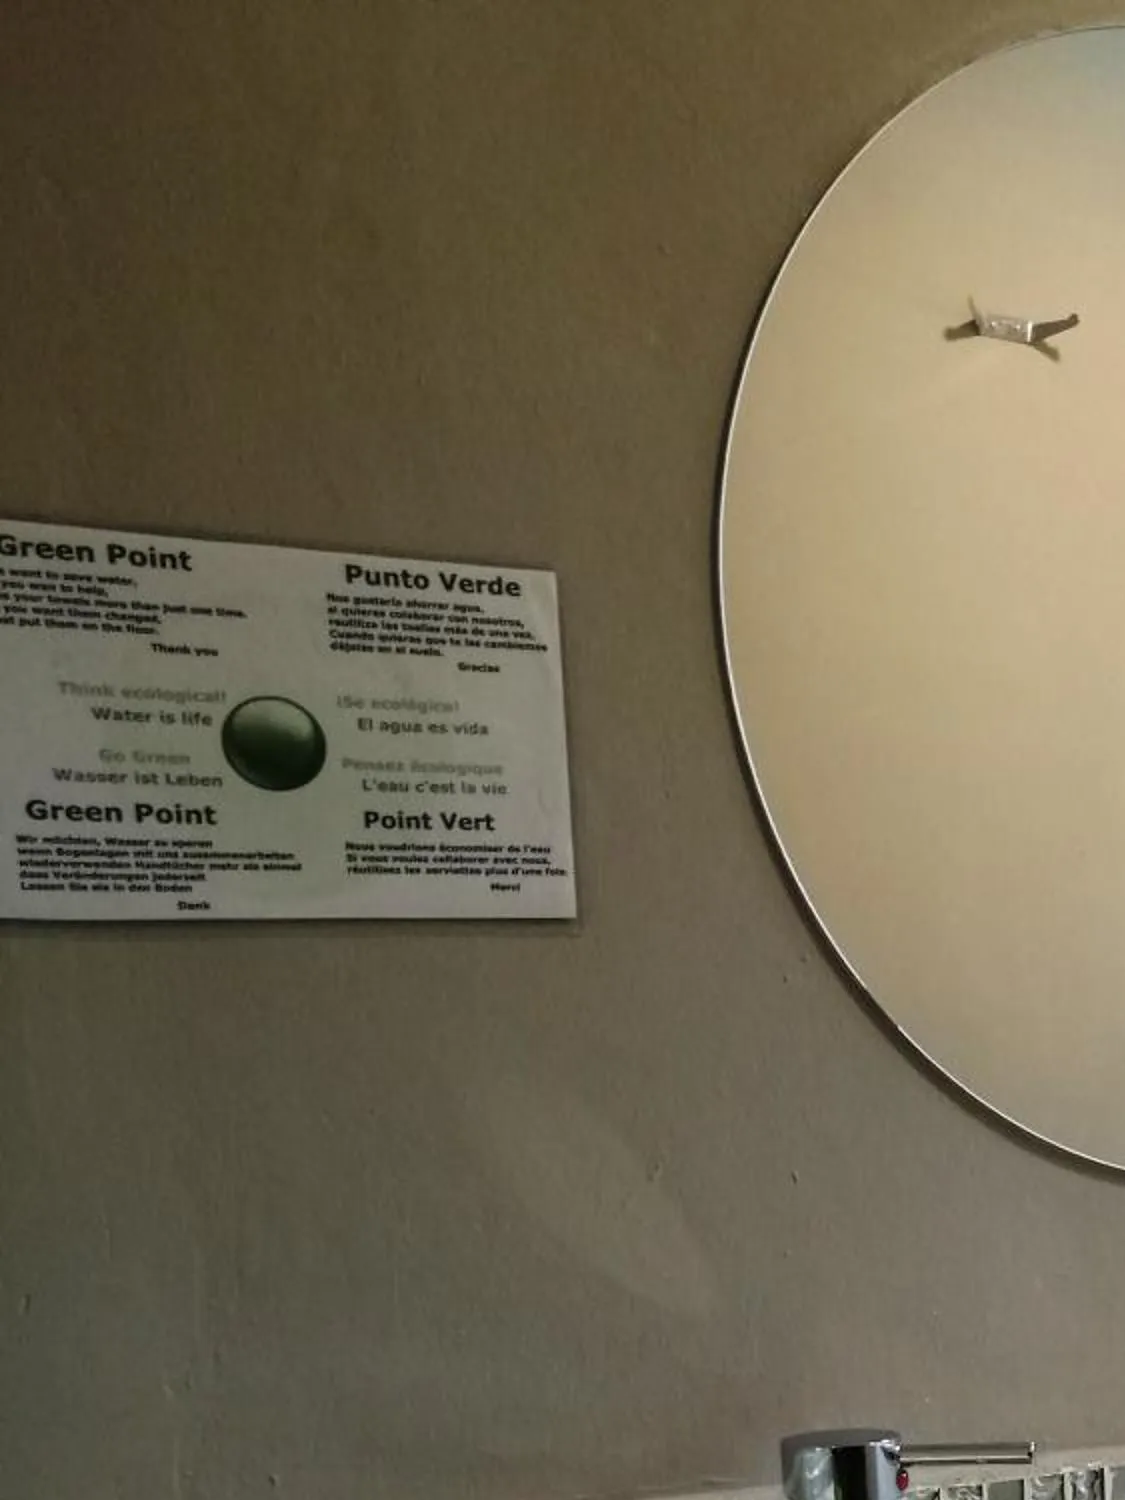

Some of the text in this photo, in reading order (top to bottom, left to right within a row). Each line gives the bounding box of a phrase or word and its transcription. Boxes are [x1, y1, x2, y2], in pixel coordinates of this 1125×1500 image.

[0, 534, 192, 571] Green Point
[345, 564, 522, 597] Punto Verde
[151, 643, 219, 657] Thank you
[457, 661, 500, 673] Gracias
[58, 680, 114, 697] Think
[91, 706, 213, 727] Water is life
[357, 717, 490, 736] El agua es vida
[98, 748, 191, 766] Go Green
[52, 767, 223, 788] Wasser ist Leben
[362, 778, 508, 795] L'eau c'est la vie
[25, 799, 218, 826] Green Point
[363, 810, 496, 832] Point Vert
[490, 883, 521, 892] Merci
[177, 900, 211, 910] Dank
